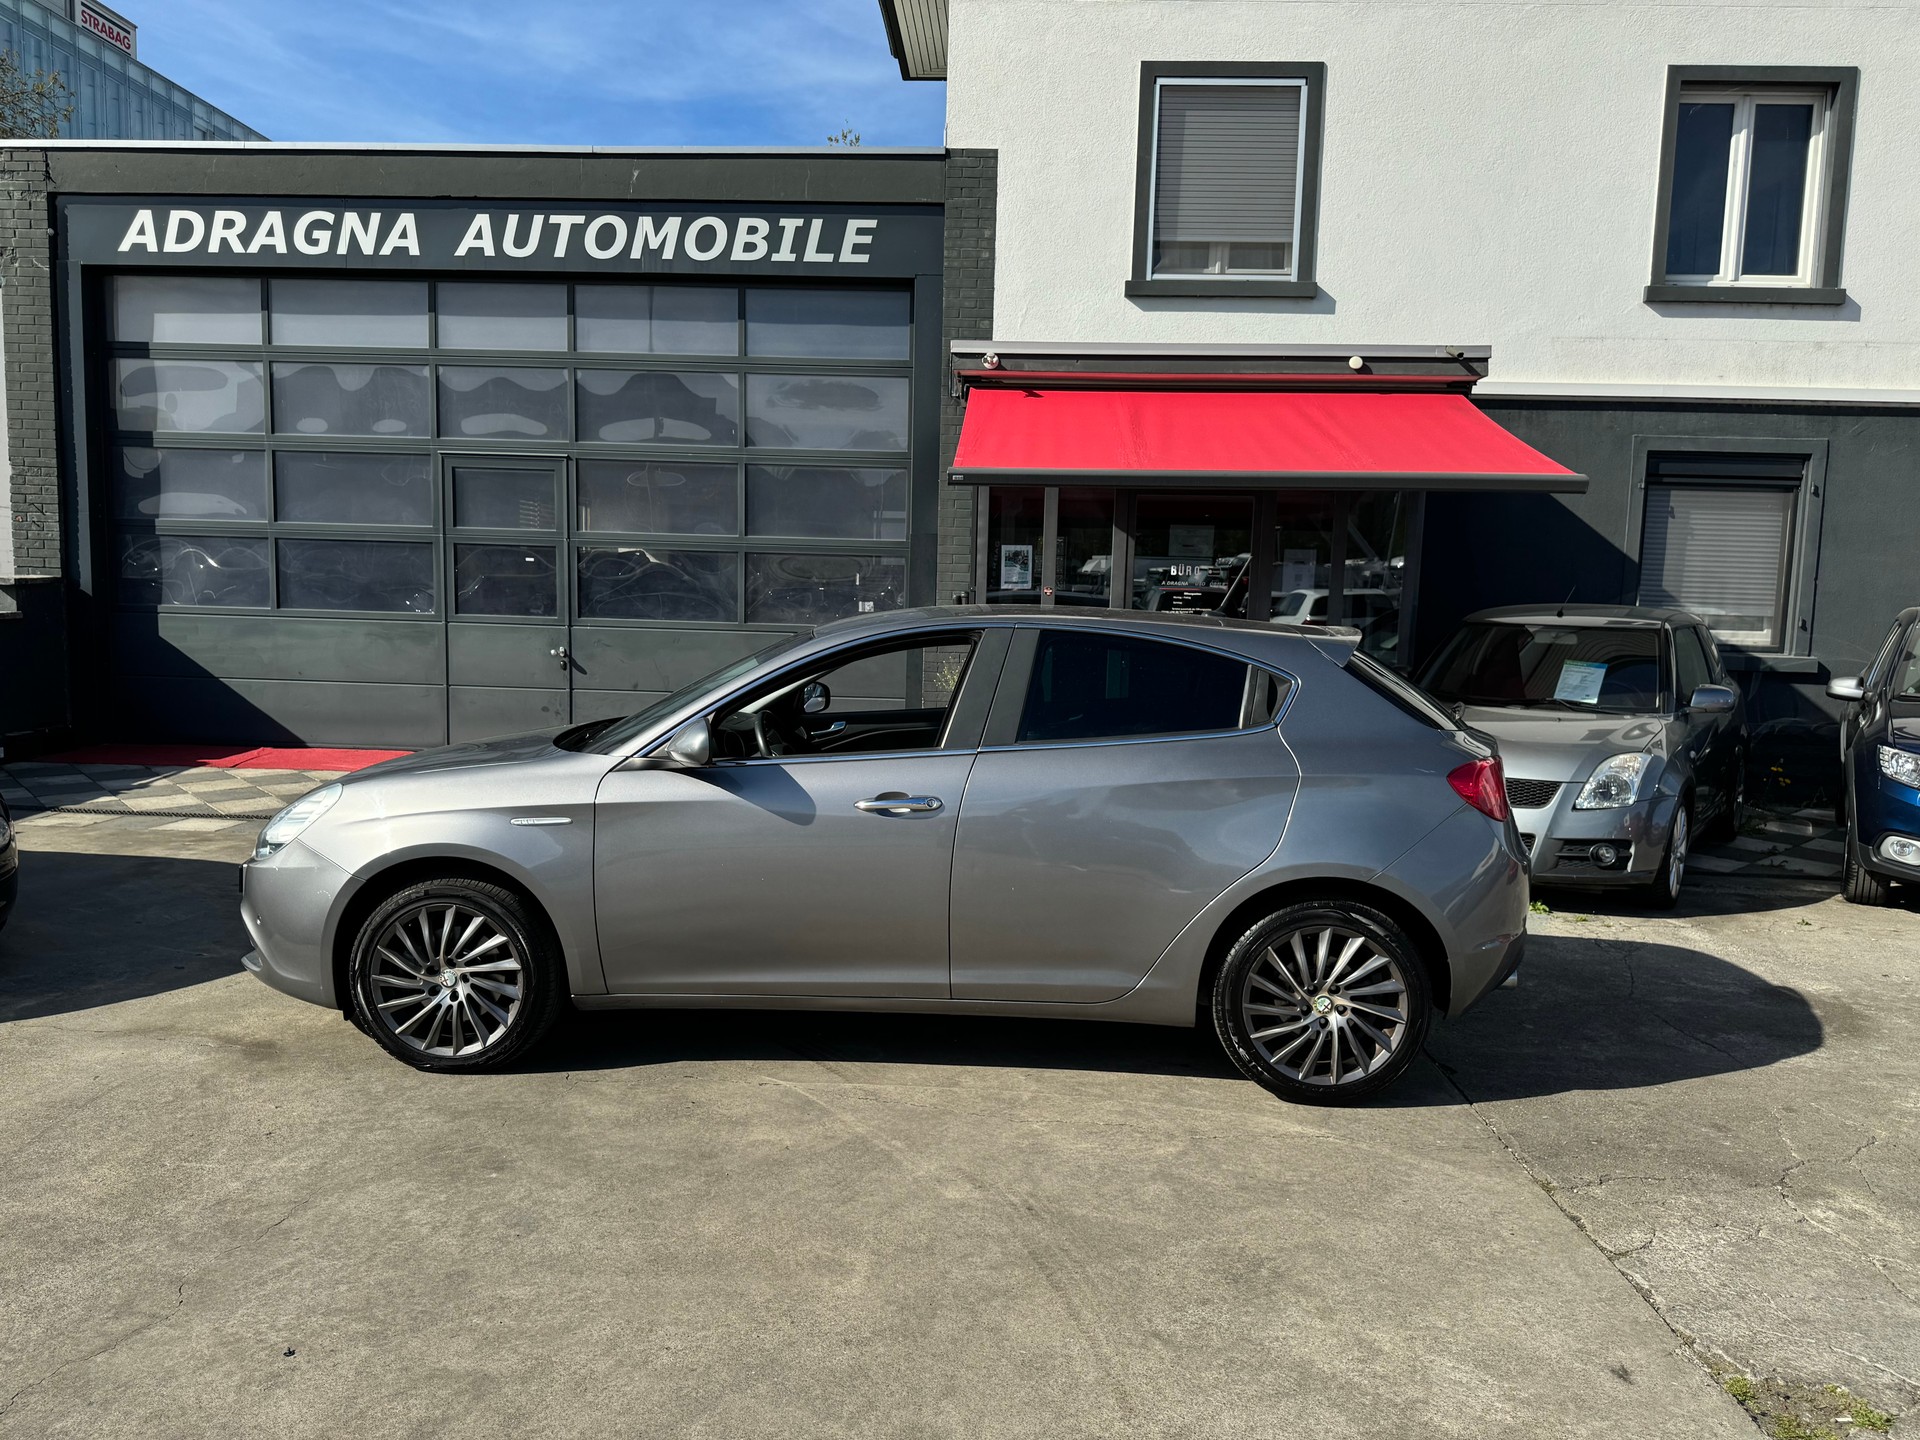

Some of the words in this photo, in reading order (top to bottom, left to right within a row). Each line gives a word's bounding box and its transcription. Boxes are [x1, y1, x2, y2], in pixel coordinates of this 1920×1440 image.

[81, 9, 131, 50] STRABAG
[117, 209, 421, 256] ADRAGNA
[453, 213, 878, 264] AUTOMOBILE
[1171, 564, 1200, 575] BÜRO
